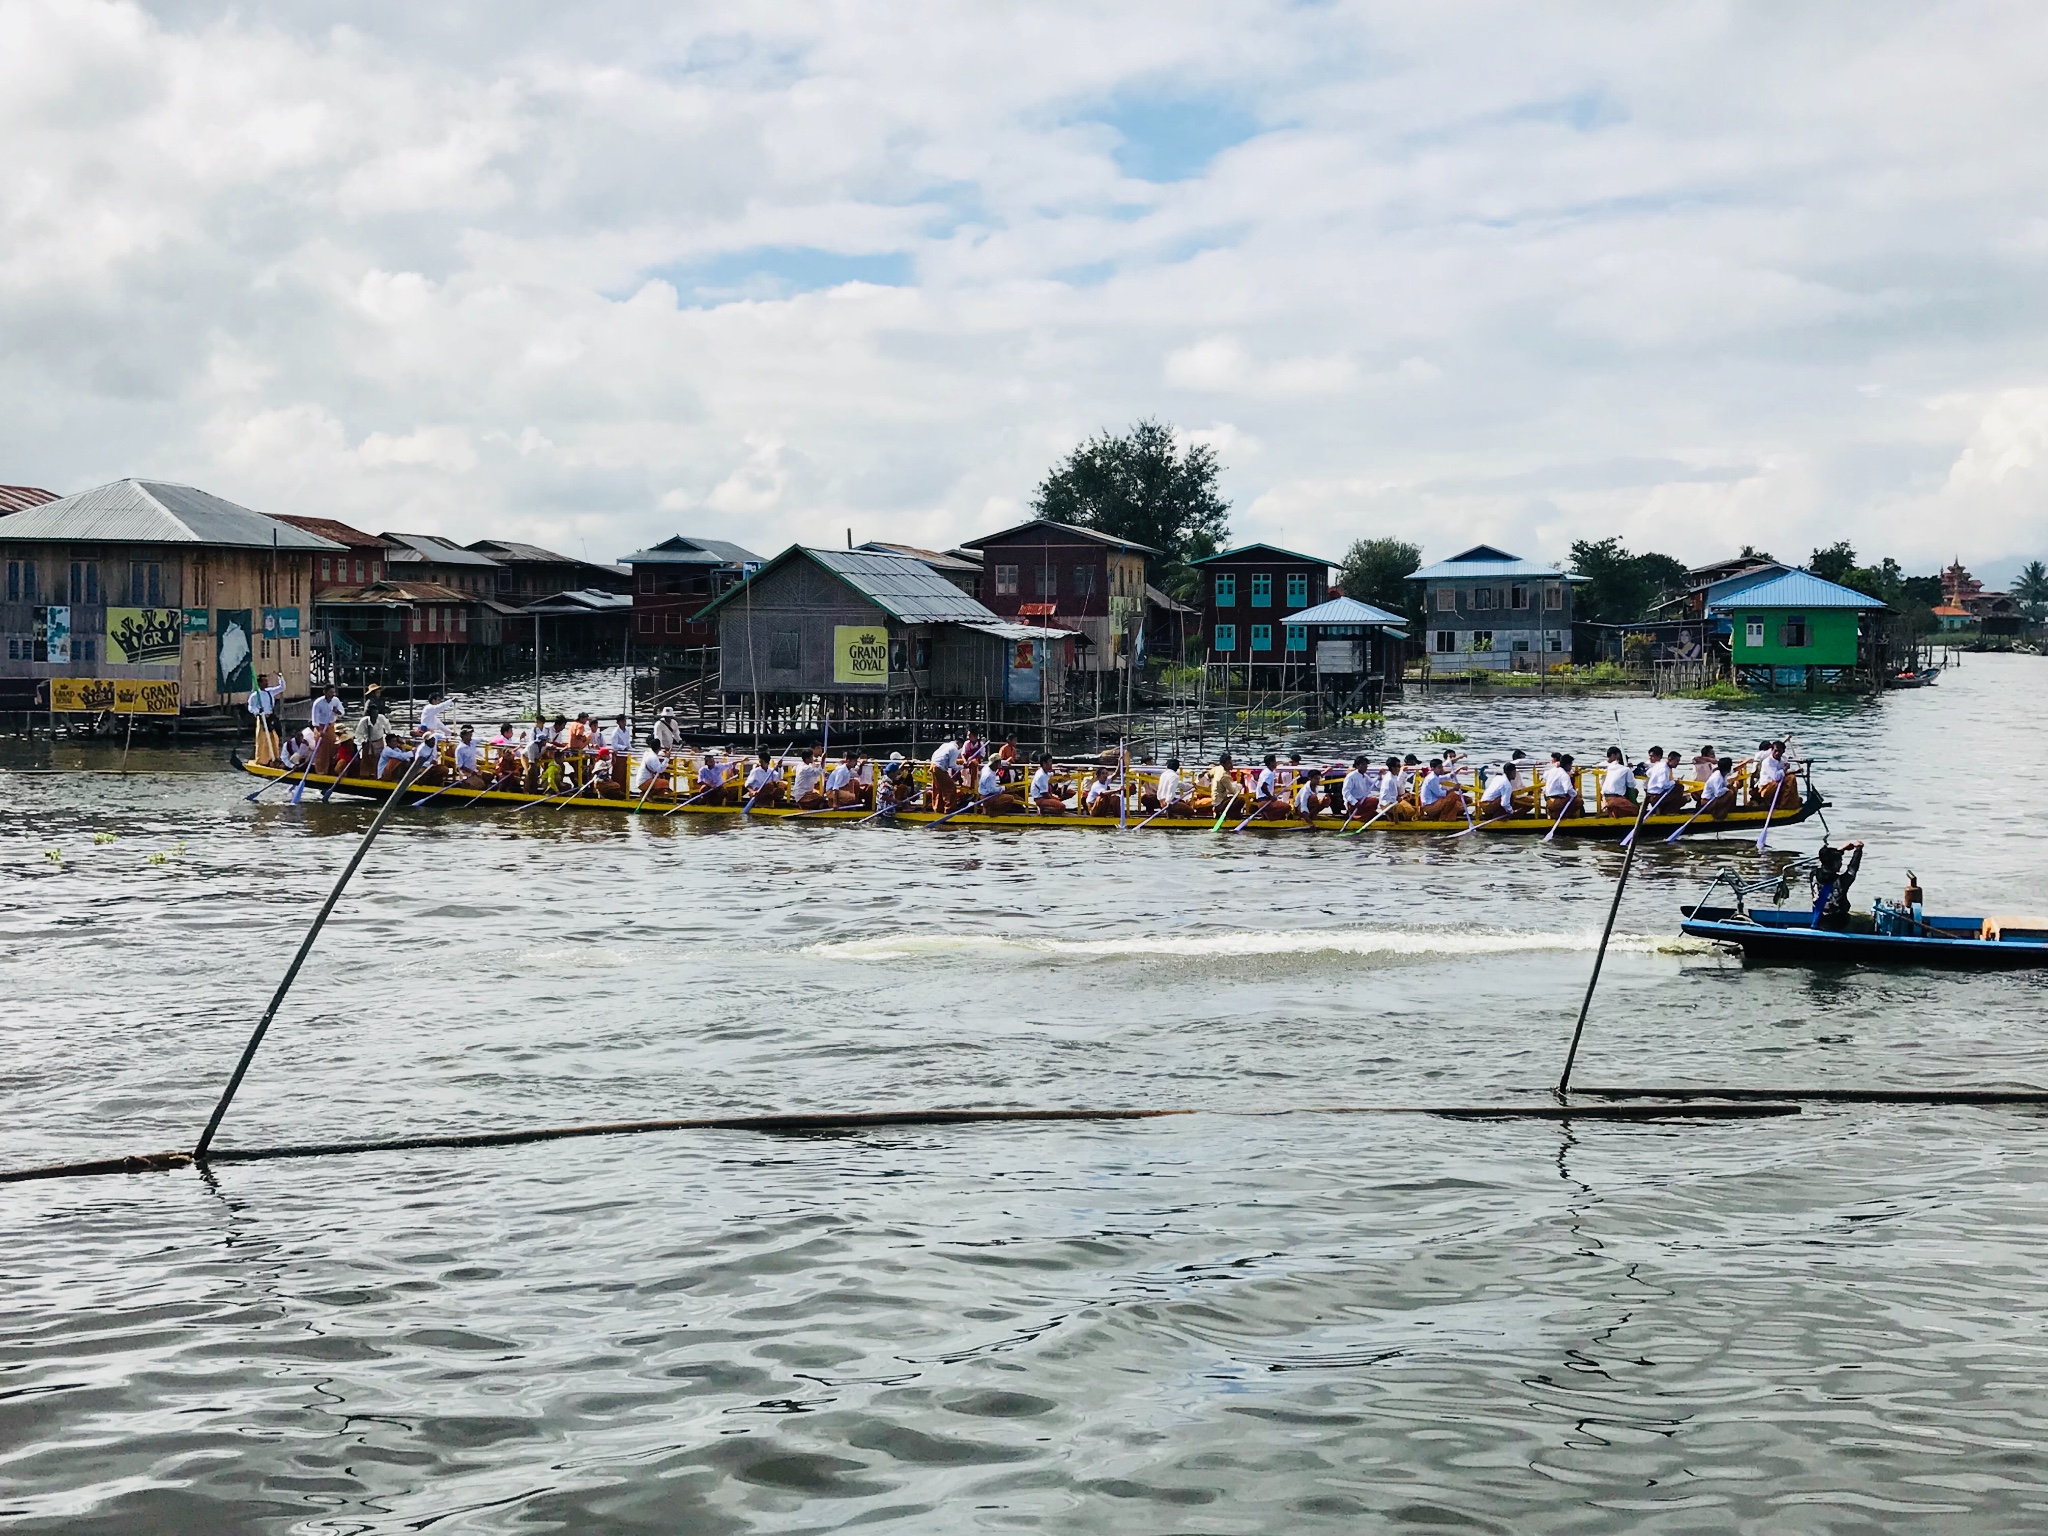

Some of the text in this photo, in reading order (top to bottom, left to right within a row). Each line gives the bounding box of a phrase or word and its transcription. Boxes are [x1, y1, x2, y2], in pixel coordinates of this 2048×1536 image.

[142, 631, 164, 646] GR
[849, 644, 886, 659] GRAND
[852, 659, 885, 671] ROYAL
[141, 682, 180, 701] GRAND
